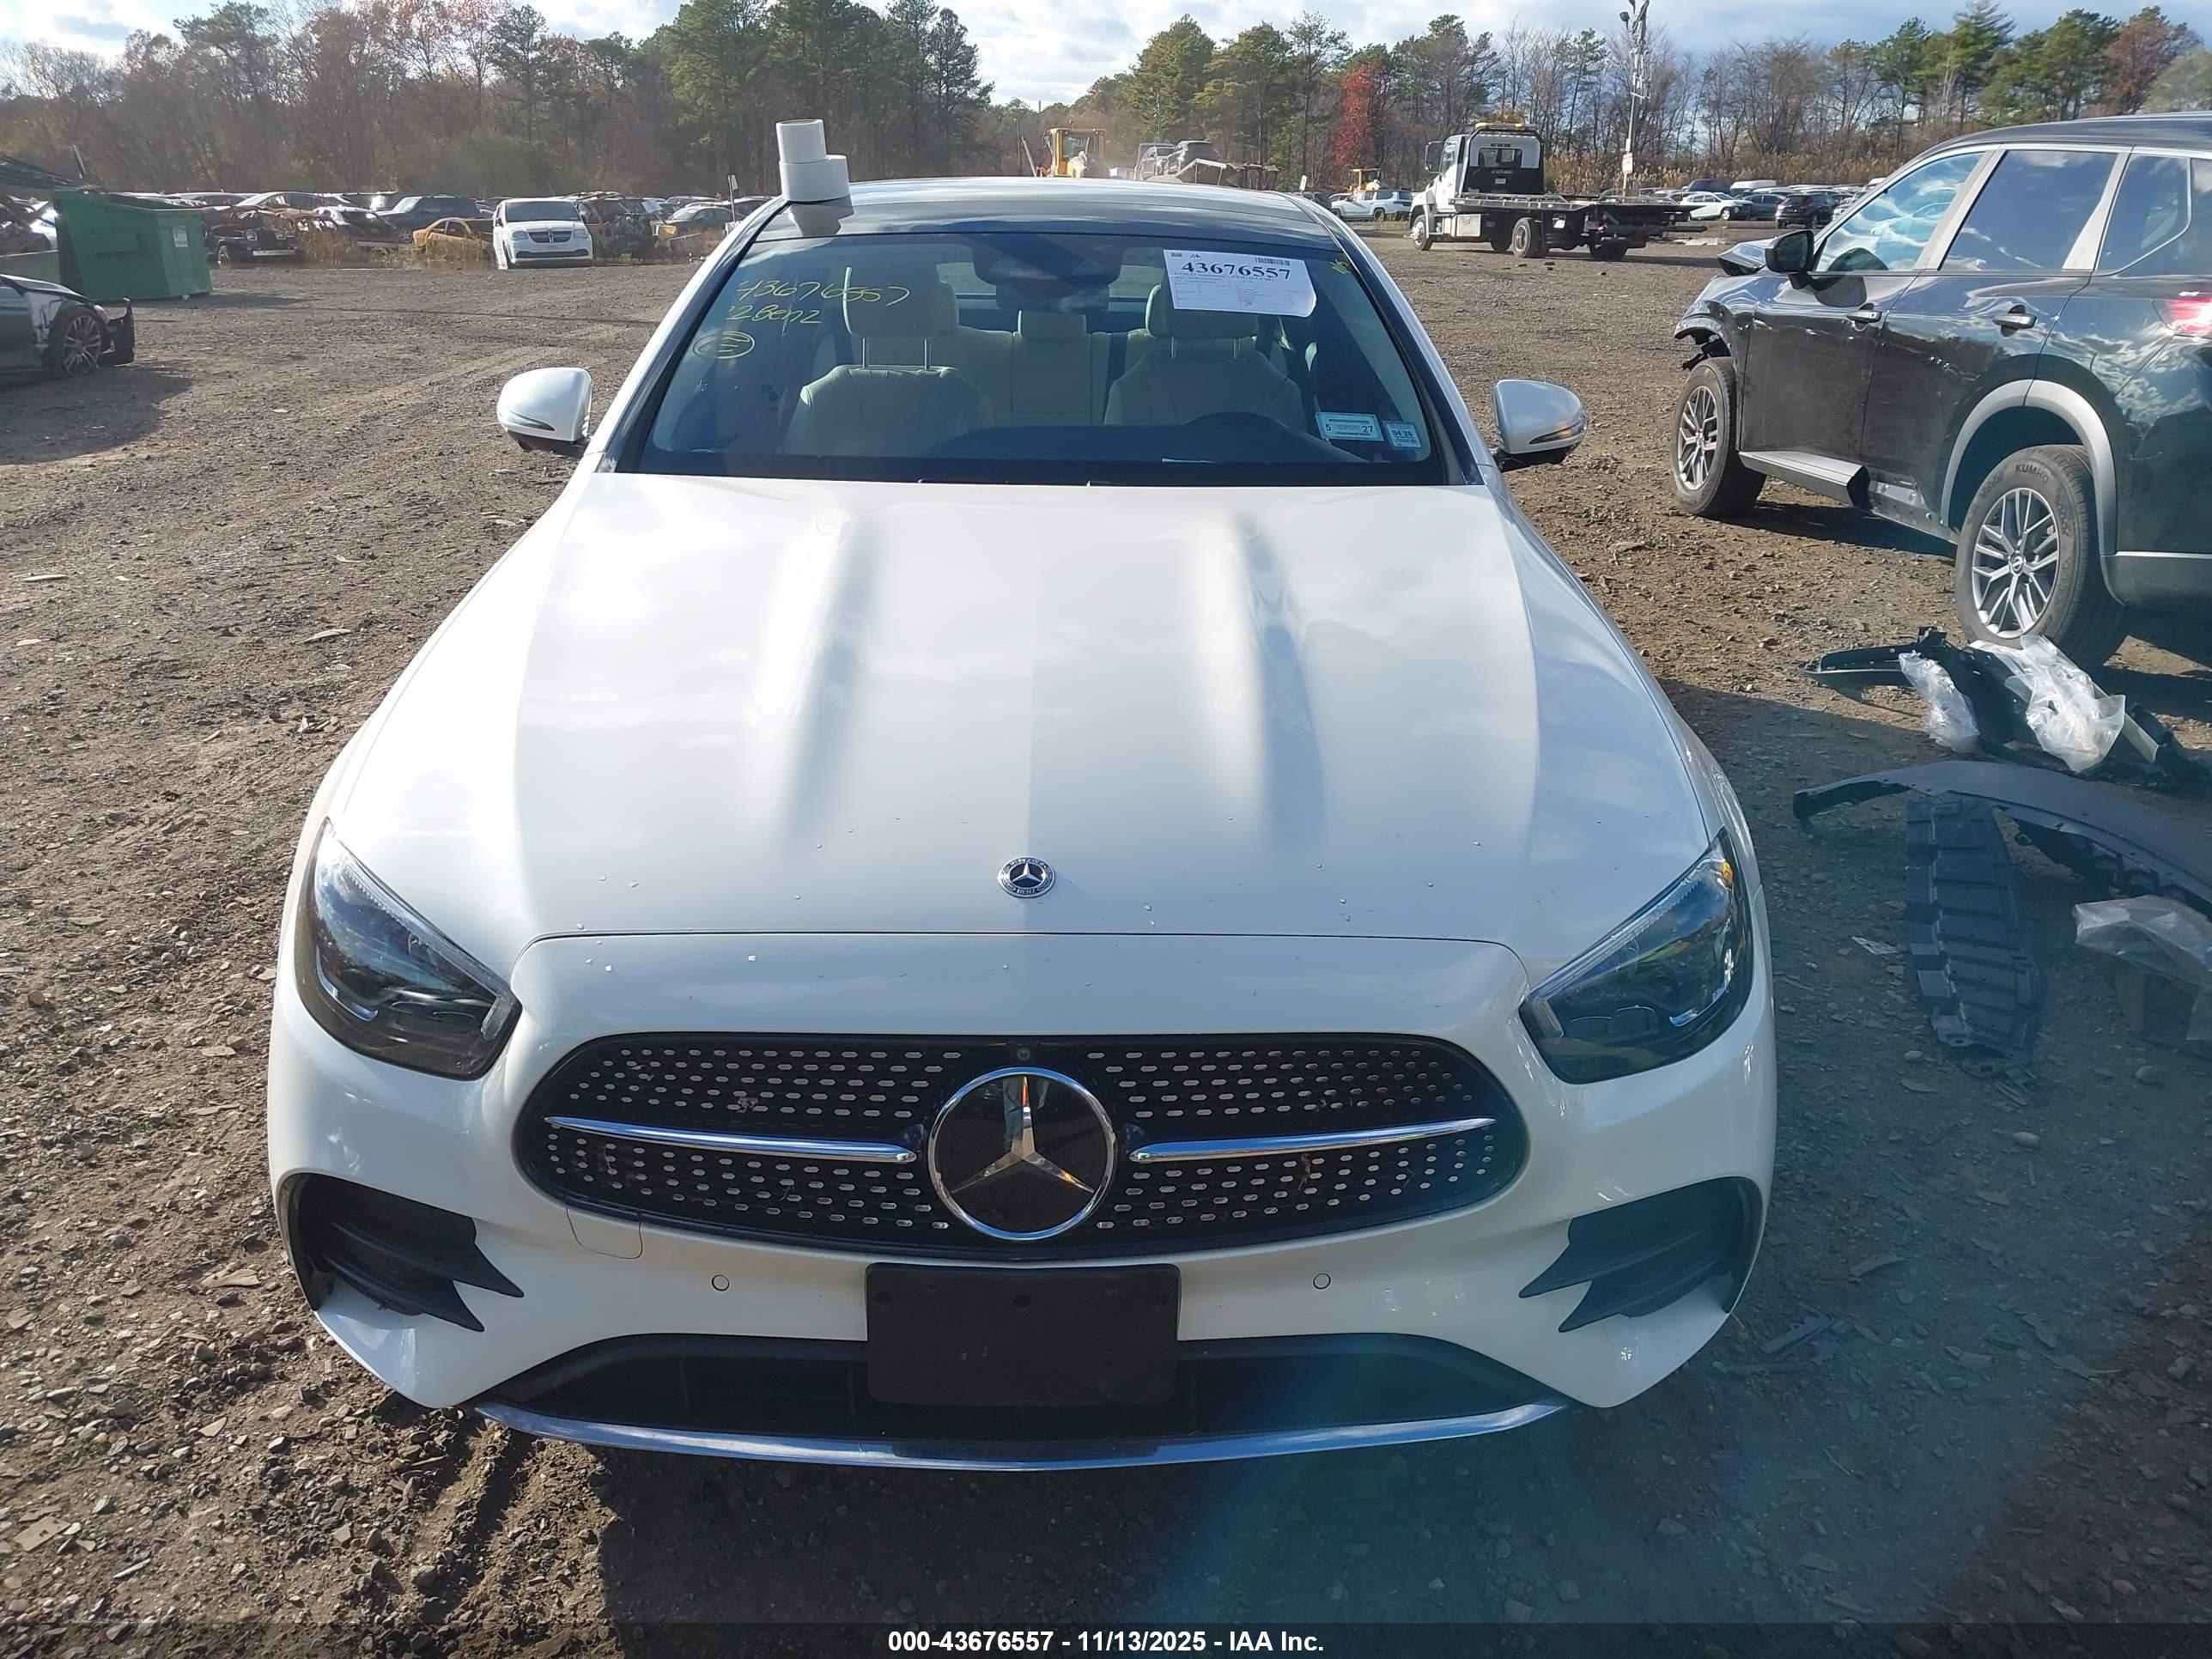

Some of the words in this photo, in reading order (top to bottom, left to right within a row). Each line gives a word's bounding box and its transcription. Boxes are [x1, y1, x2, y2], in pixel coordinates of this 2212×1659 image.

[1182, 261, 1291, 280] 43676557
[736, 279, 911, 307] 43676557
[1361, 425, 1374, 434] 27
[2015, 464, 2050, 484] KUMHO
